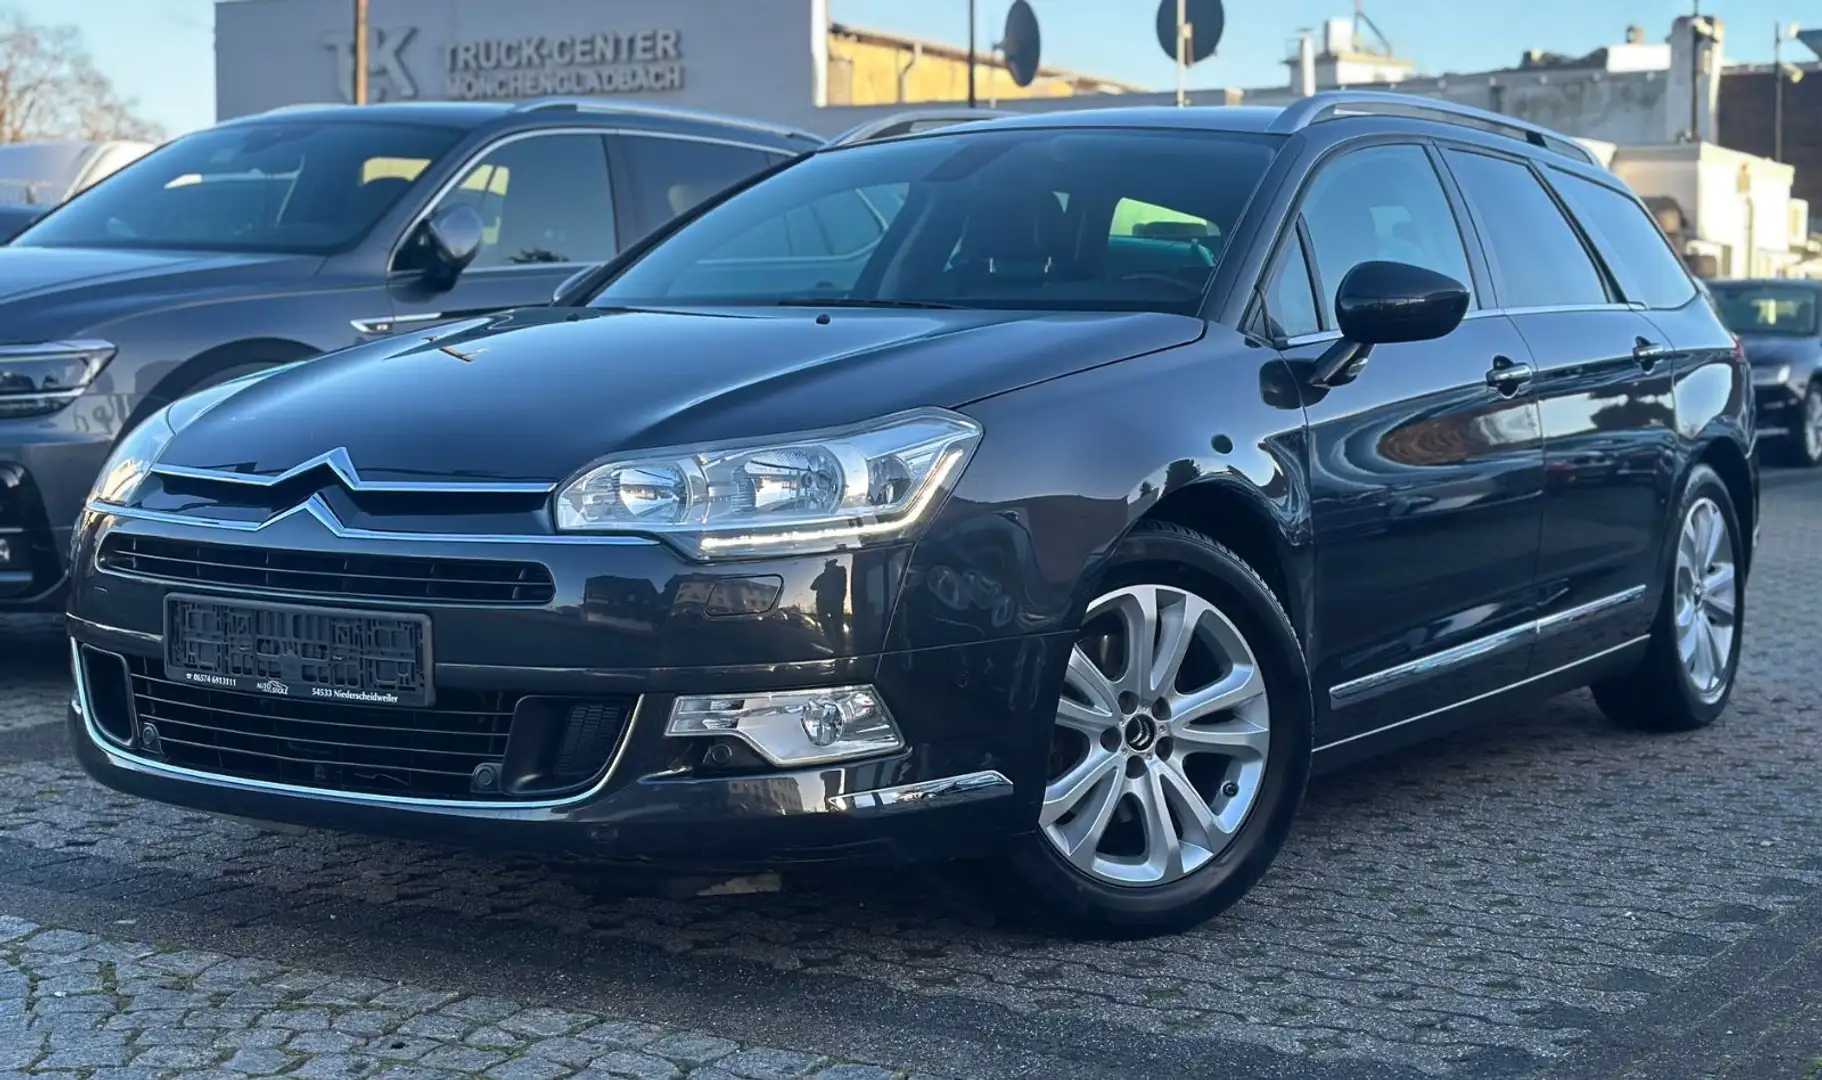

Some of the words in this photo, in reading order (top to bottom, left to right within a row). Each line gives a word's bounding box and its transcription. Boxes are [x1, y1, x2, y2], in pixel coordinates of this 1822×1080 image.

[442, 29, 681, 72] TRUCK-CENTER
[312, 687, 332, 697] 54533
[333, 689, 398, 703] Niederscheidweiler
